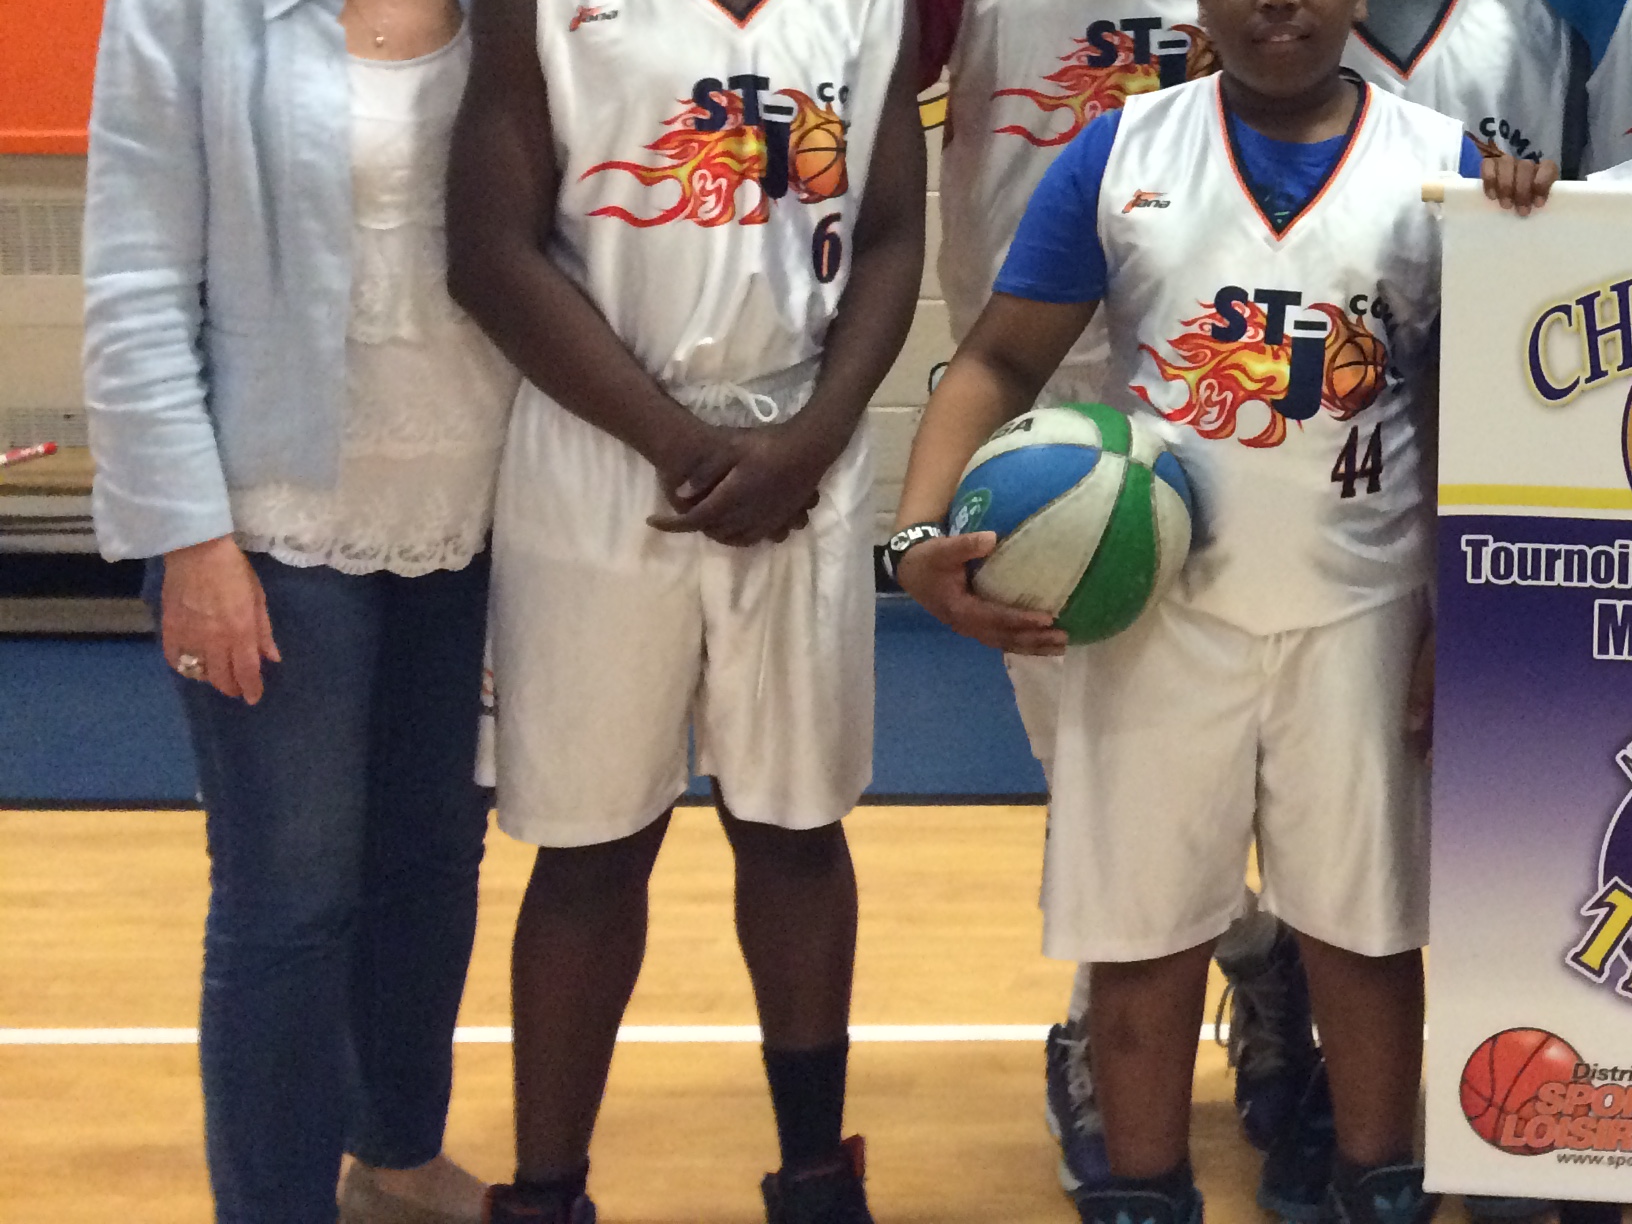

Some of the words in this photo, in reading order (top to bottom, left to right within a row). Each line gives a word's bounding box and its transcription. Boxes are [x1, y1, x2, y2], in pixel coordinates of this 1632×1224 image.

[811, 212, 842, 284] 6
[1330, 422, 1383, 499] 44
[1461, 534, 1632, 589] Tournoi
